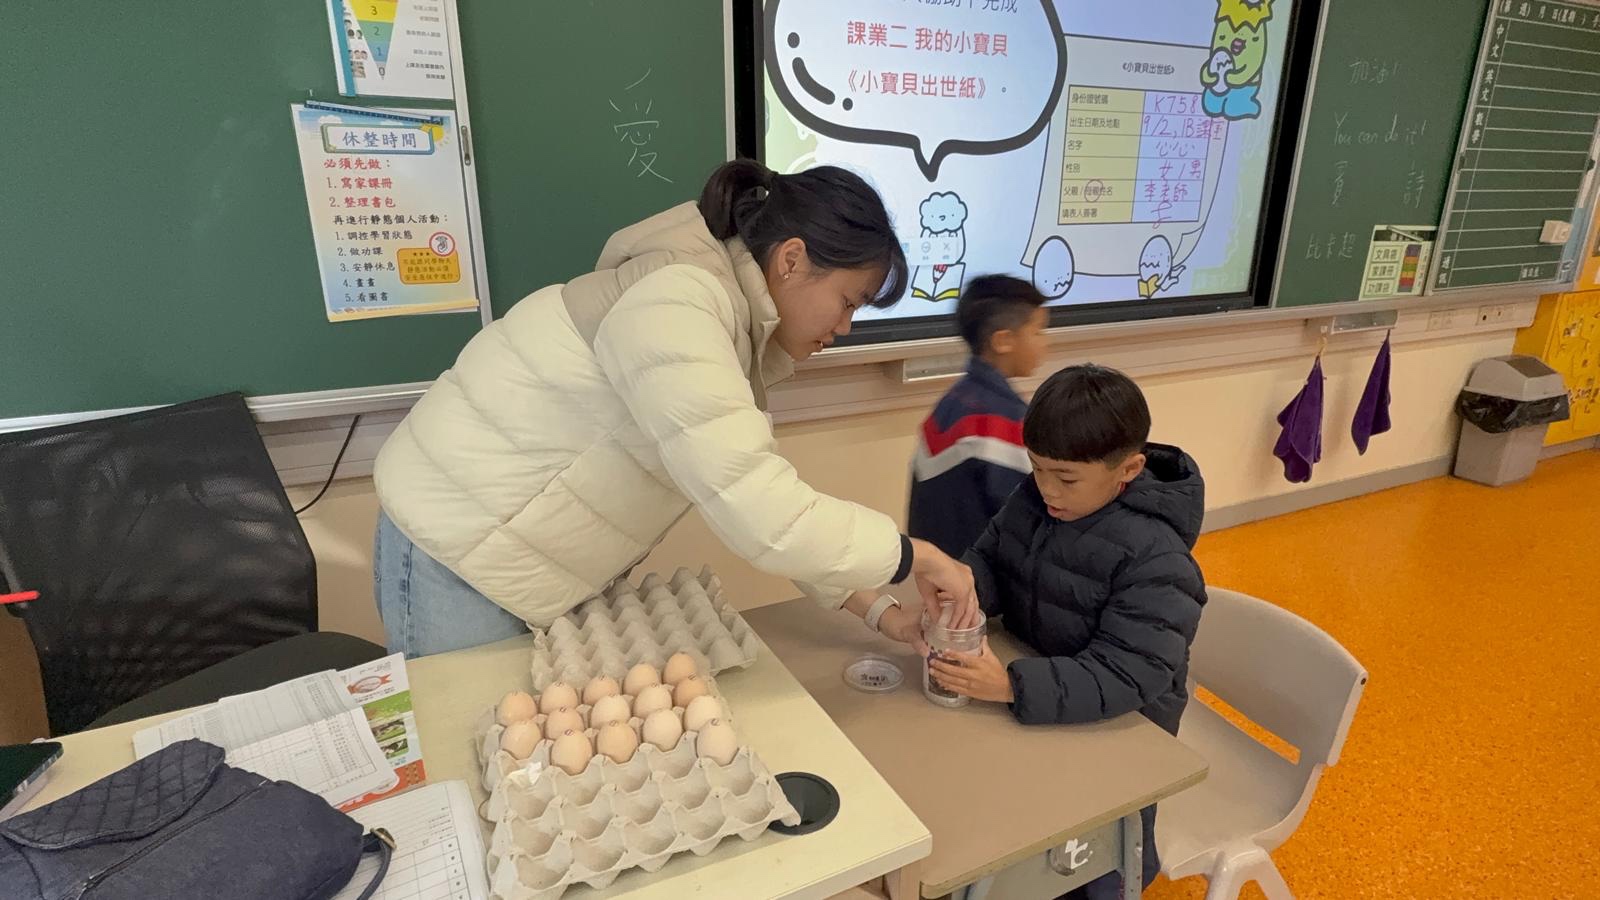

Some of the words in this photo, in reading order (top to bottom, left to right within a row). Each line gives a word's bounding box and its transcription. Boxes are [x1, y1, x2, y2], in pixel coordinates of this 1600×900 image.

[371, 6, 378, 15] 3
[374, 27, 380, 36] 2
[847, 21, 907, 49] 課業二
[915, 28, 1008, 57] 我的小寶貝
[377, 48, 382, 56] 1
[379, 67, 385, 76] 0
[1122, 62, 1175, 75] 《小寶貝出世紙》
[1072, 94, 1108, 104] 身份證號碼
[1155, 95, 1199, 113] K758
[609, 66, 673, 183] 愛
[1069, 117, 1120, 128] 出生日期及地點
[1358, 131, 1377, 144] can
[1385, 114, 1398, 143] do
[342, 131, 417, 148] 休整時間
[1067, 139, 1082, 150] 名字
[1156, 141, 1196, 157] 心心
[323, 157, 391, 170] 必須先做：
[1065, 163, 1081, 173] 性別
[1144, 180, 1188, 202] 李老師
